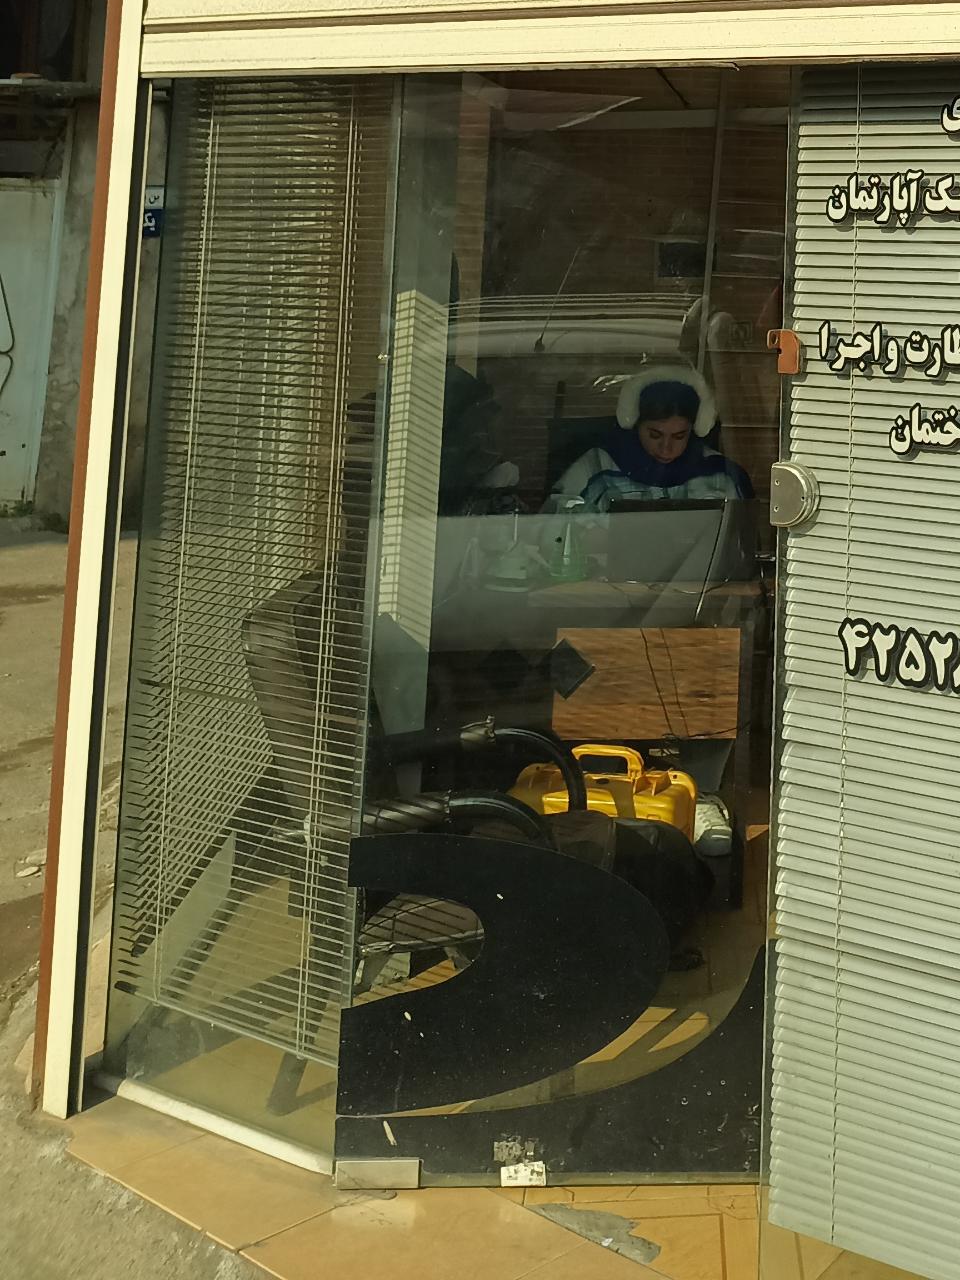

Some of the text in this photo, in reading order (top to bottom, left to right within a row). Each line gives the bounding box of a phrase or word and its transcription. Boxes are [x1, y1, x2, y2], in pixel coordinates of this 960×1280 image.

[826, 168, 924, 226] آپارتمان
[818, 320, 883, 371] اجرا
[882, 336, 899, 374] و
